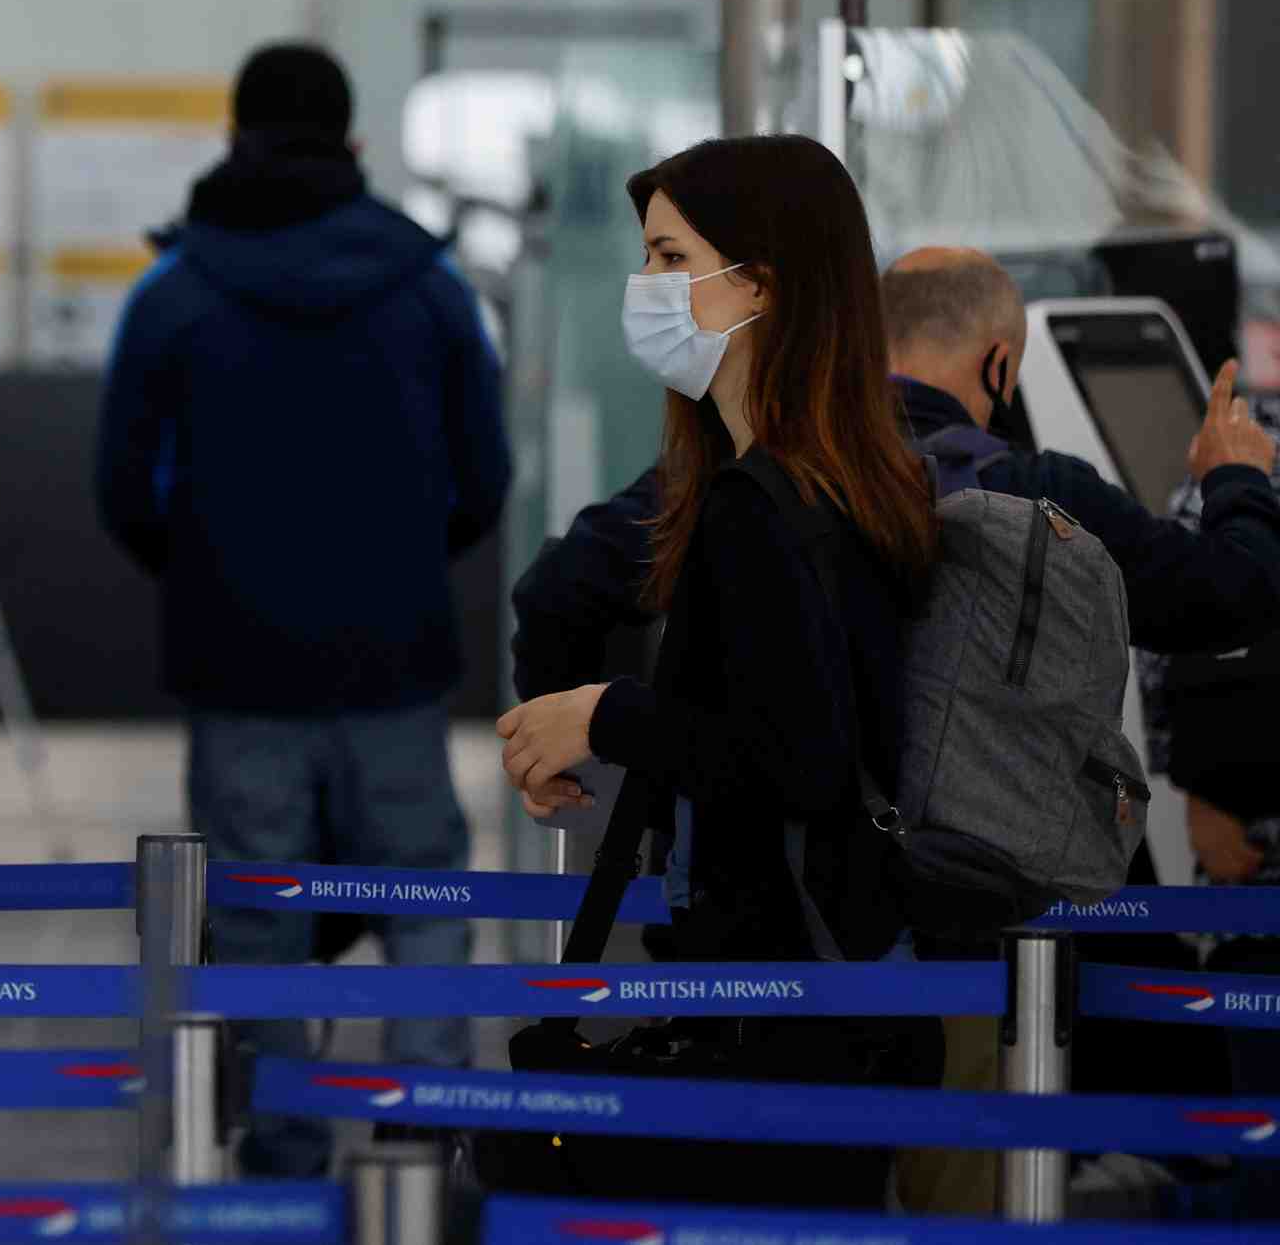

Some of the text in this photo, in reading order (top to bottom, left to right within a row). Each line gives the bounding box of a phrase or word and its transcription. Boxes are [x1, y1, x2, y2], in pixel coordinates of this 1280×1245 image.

[311, 880, 472, 903] BRITISH AIRWAYS
[619, 980, 804, 999] BRITISH AIRWAYS
[412, 1084, 622, 1115] BRITISH AIRWAYS
